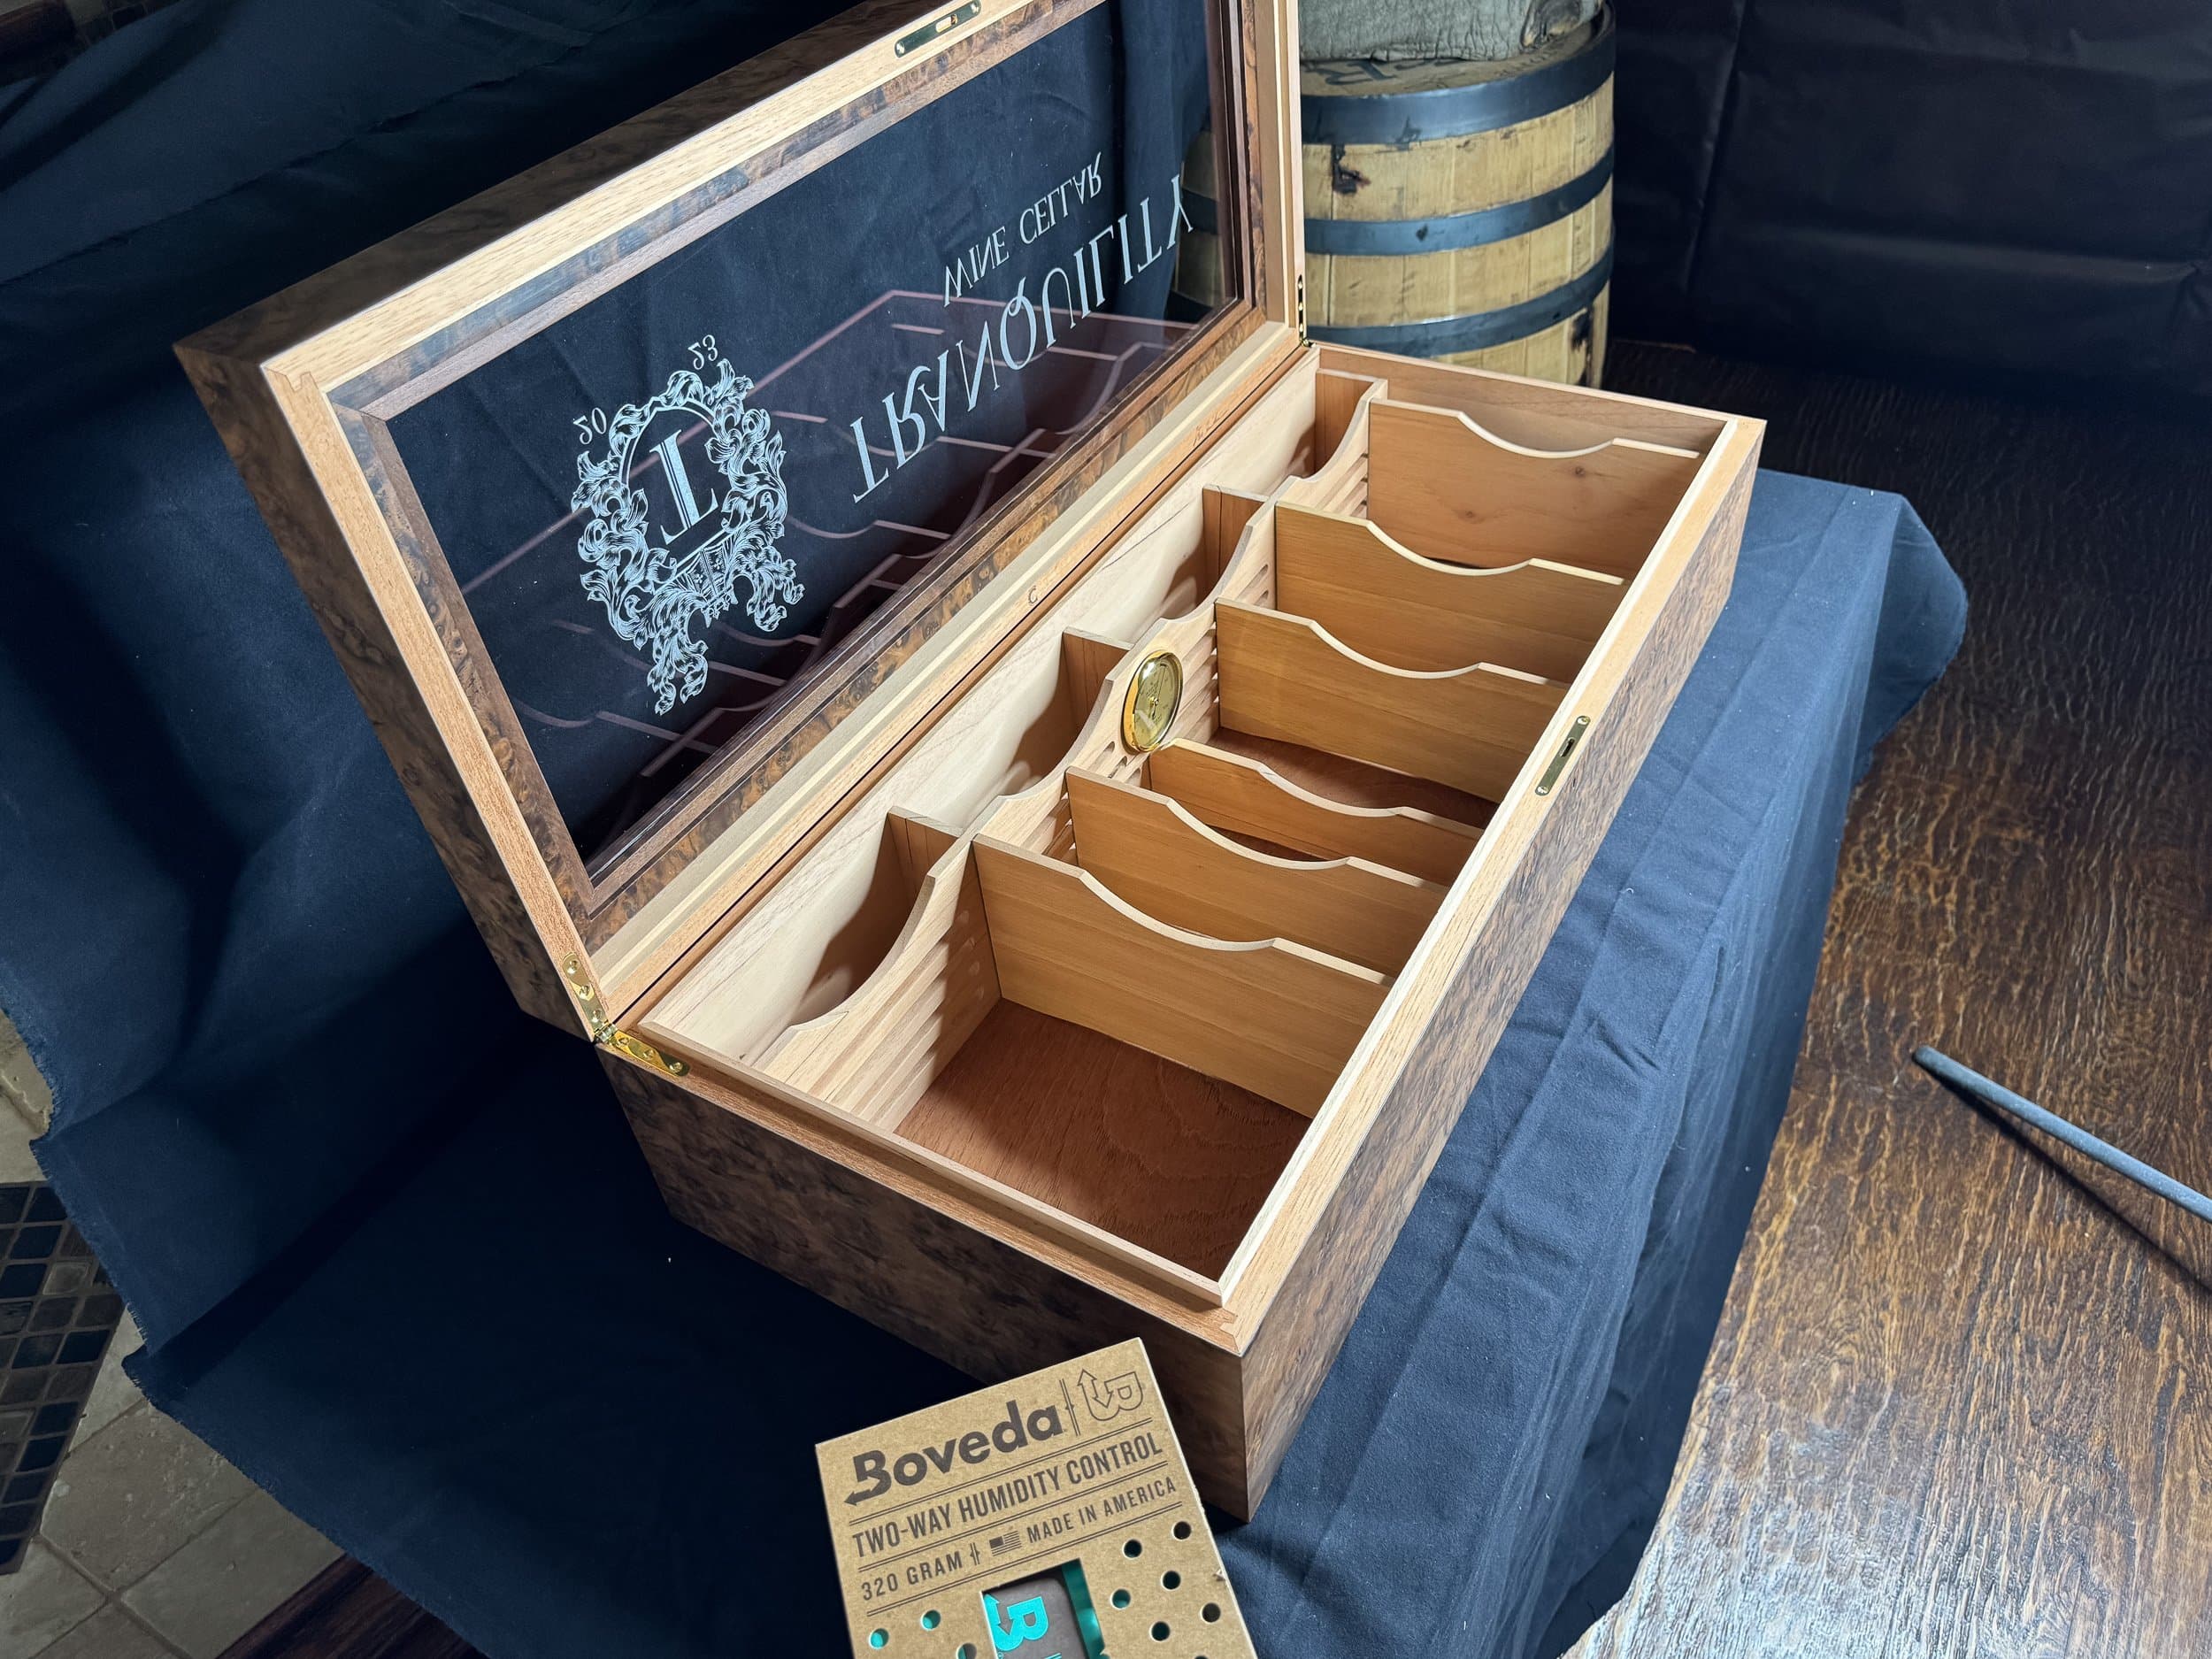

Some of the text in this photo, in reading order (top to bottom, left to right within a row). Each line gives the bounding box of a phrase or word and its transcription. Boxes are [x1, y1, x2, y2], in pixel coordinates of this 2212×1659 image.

[844, 1400, 1062, 1506] Boveda
[852, 1432, 1163, 1558] TWO-WAY HUMIDITY CONTROL
[861, 1476, 1177, 1601] 320 GRAM MADE IN AMERICA
